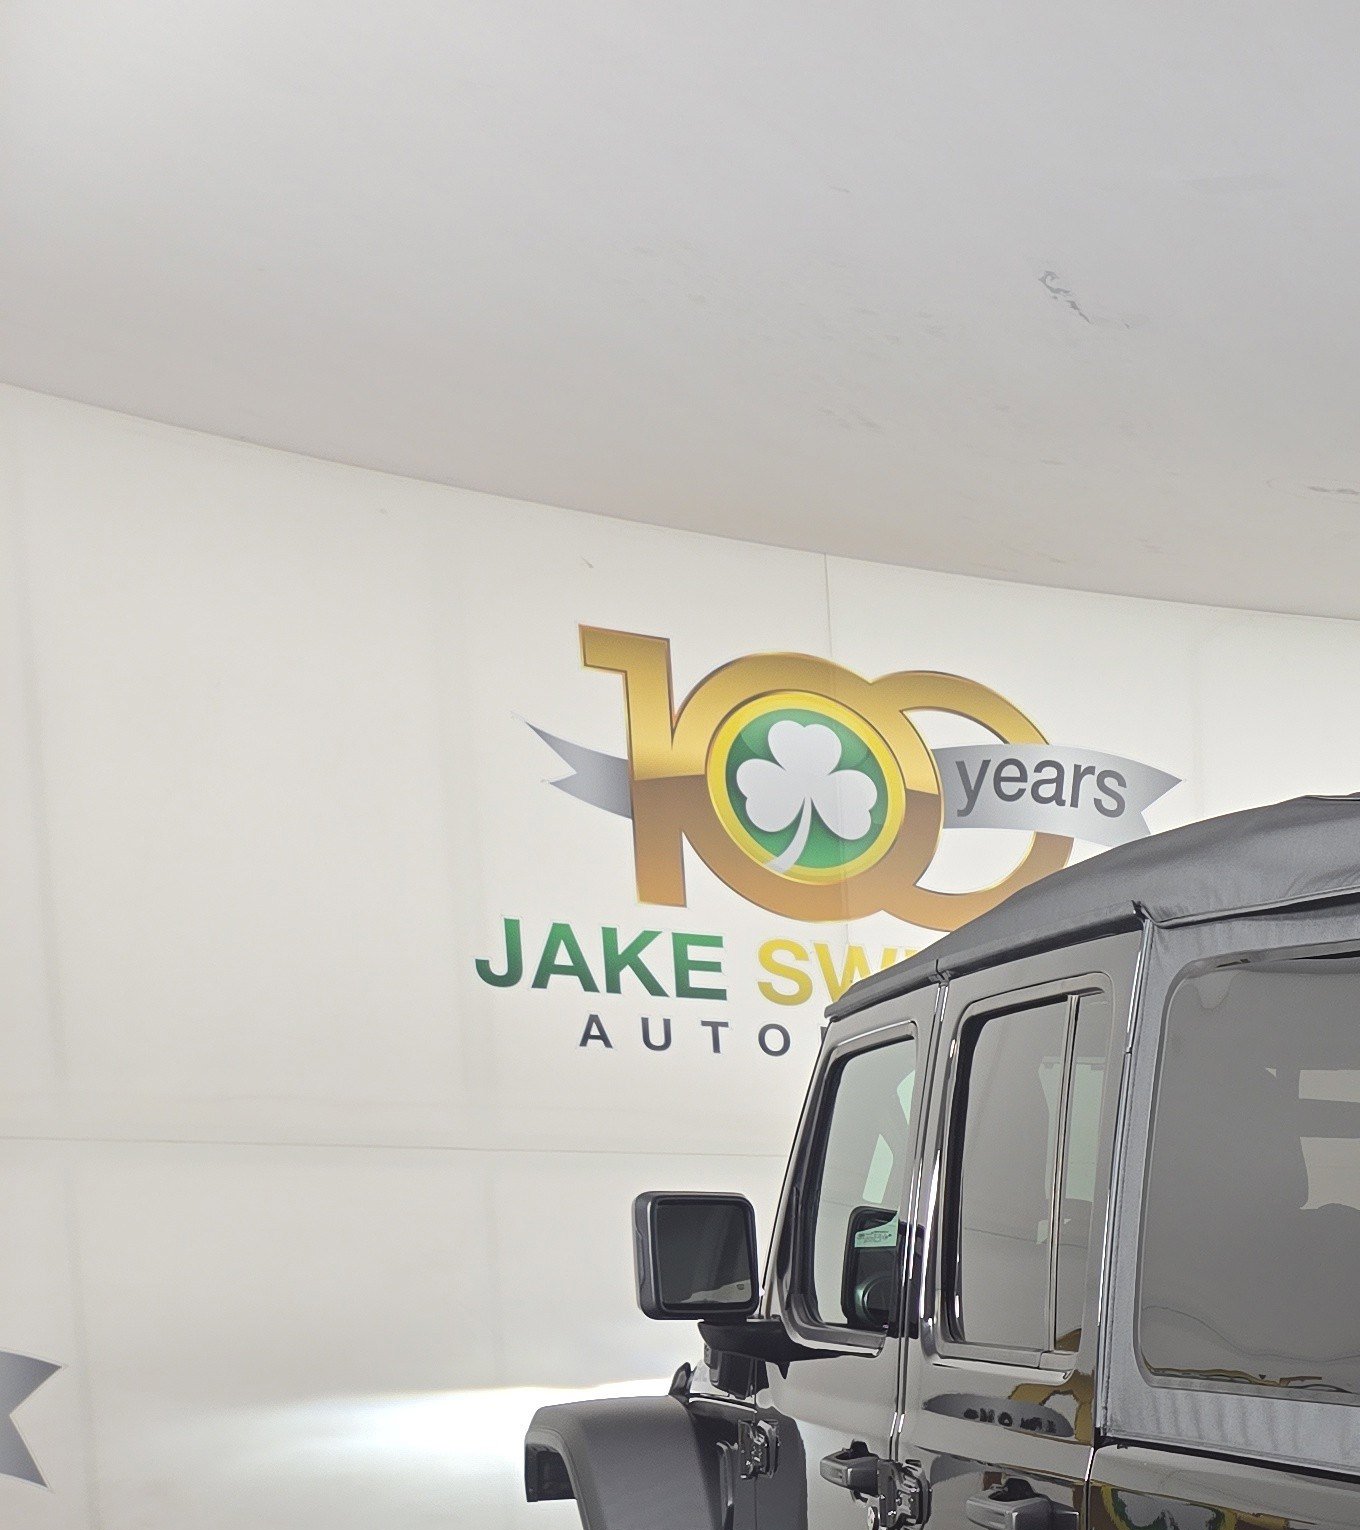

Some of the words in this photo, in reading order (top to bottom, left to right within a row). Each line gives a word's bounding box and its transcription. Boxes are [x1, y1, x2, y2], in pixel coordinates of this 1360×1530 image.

[954, 757, 1129, 819] years
[474, 917, 729, 1001] JAKE
[757, 938, 920, 1006] SW
[578, 1013, 828, 1058] AUTO
